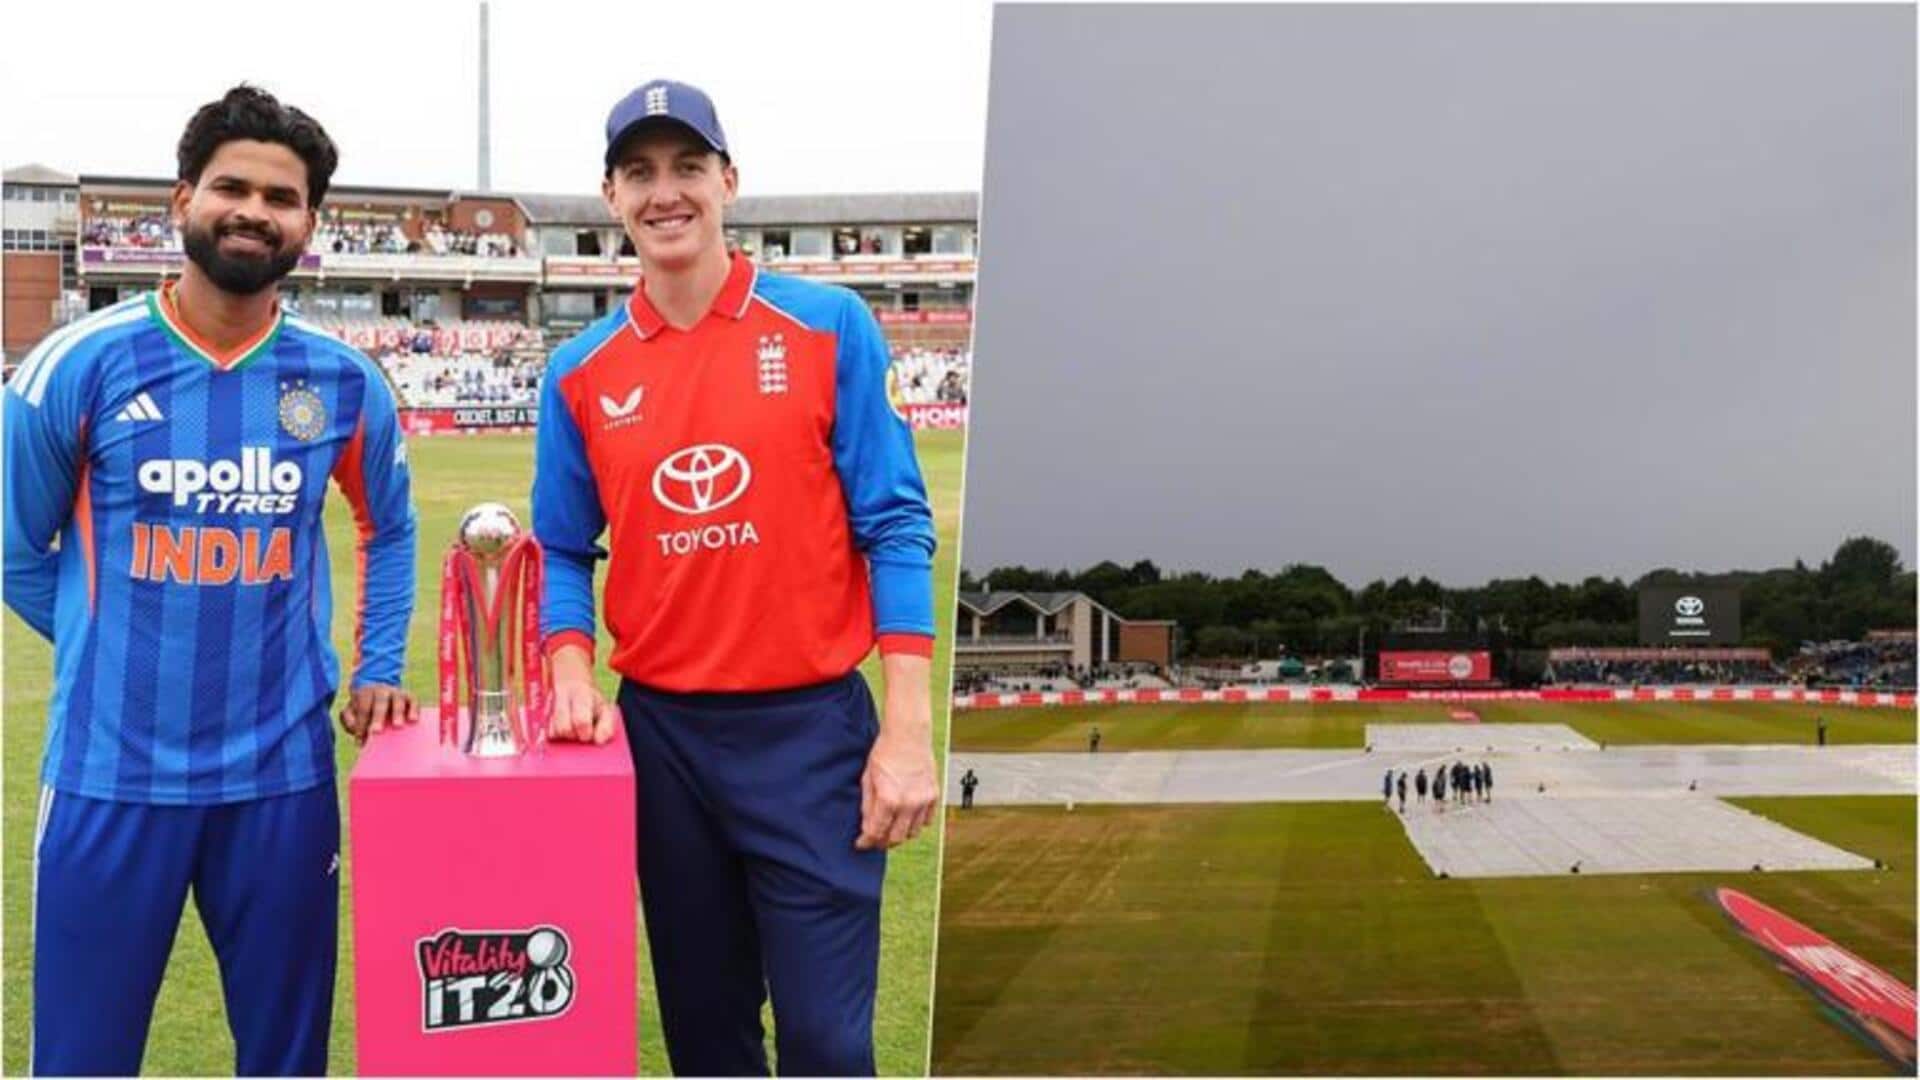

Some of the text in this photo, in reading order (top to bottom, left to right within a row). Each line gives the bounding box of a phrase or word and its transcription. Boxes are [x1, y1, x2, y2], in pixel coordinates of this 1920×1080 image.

[912, 407, 968, 425] HOM
[138, 446, 302, 506] apollo
[196, 492, 298, 514] TYRES
[130, 522, 294, 586] INDIA
[657, 521, 760, 557] TOYOTA
[423, 934, 528, 979] Vitality
[428, 966, 571, 1026] IT20
